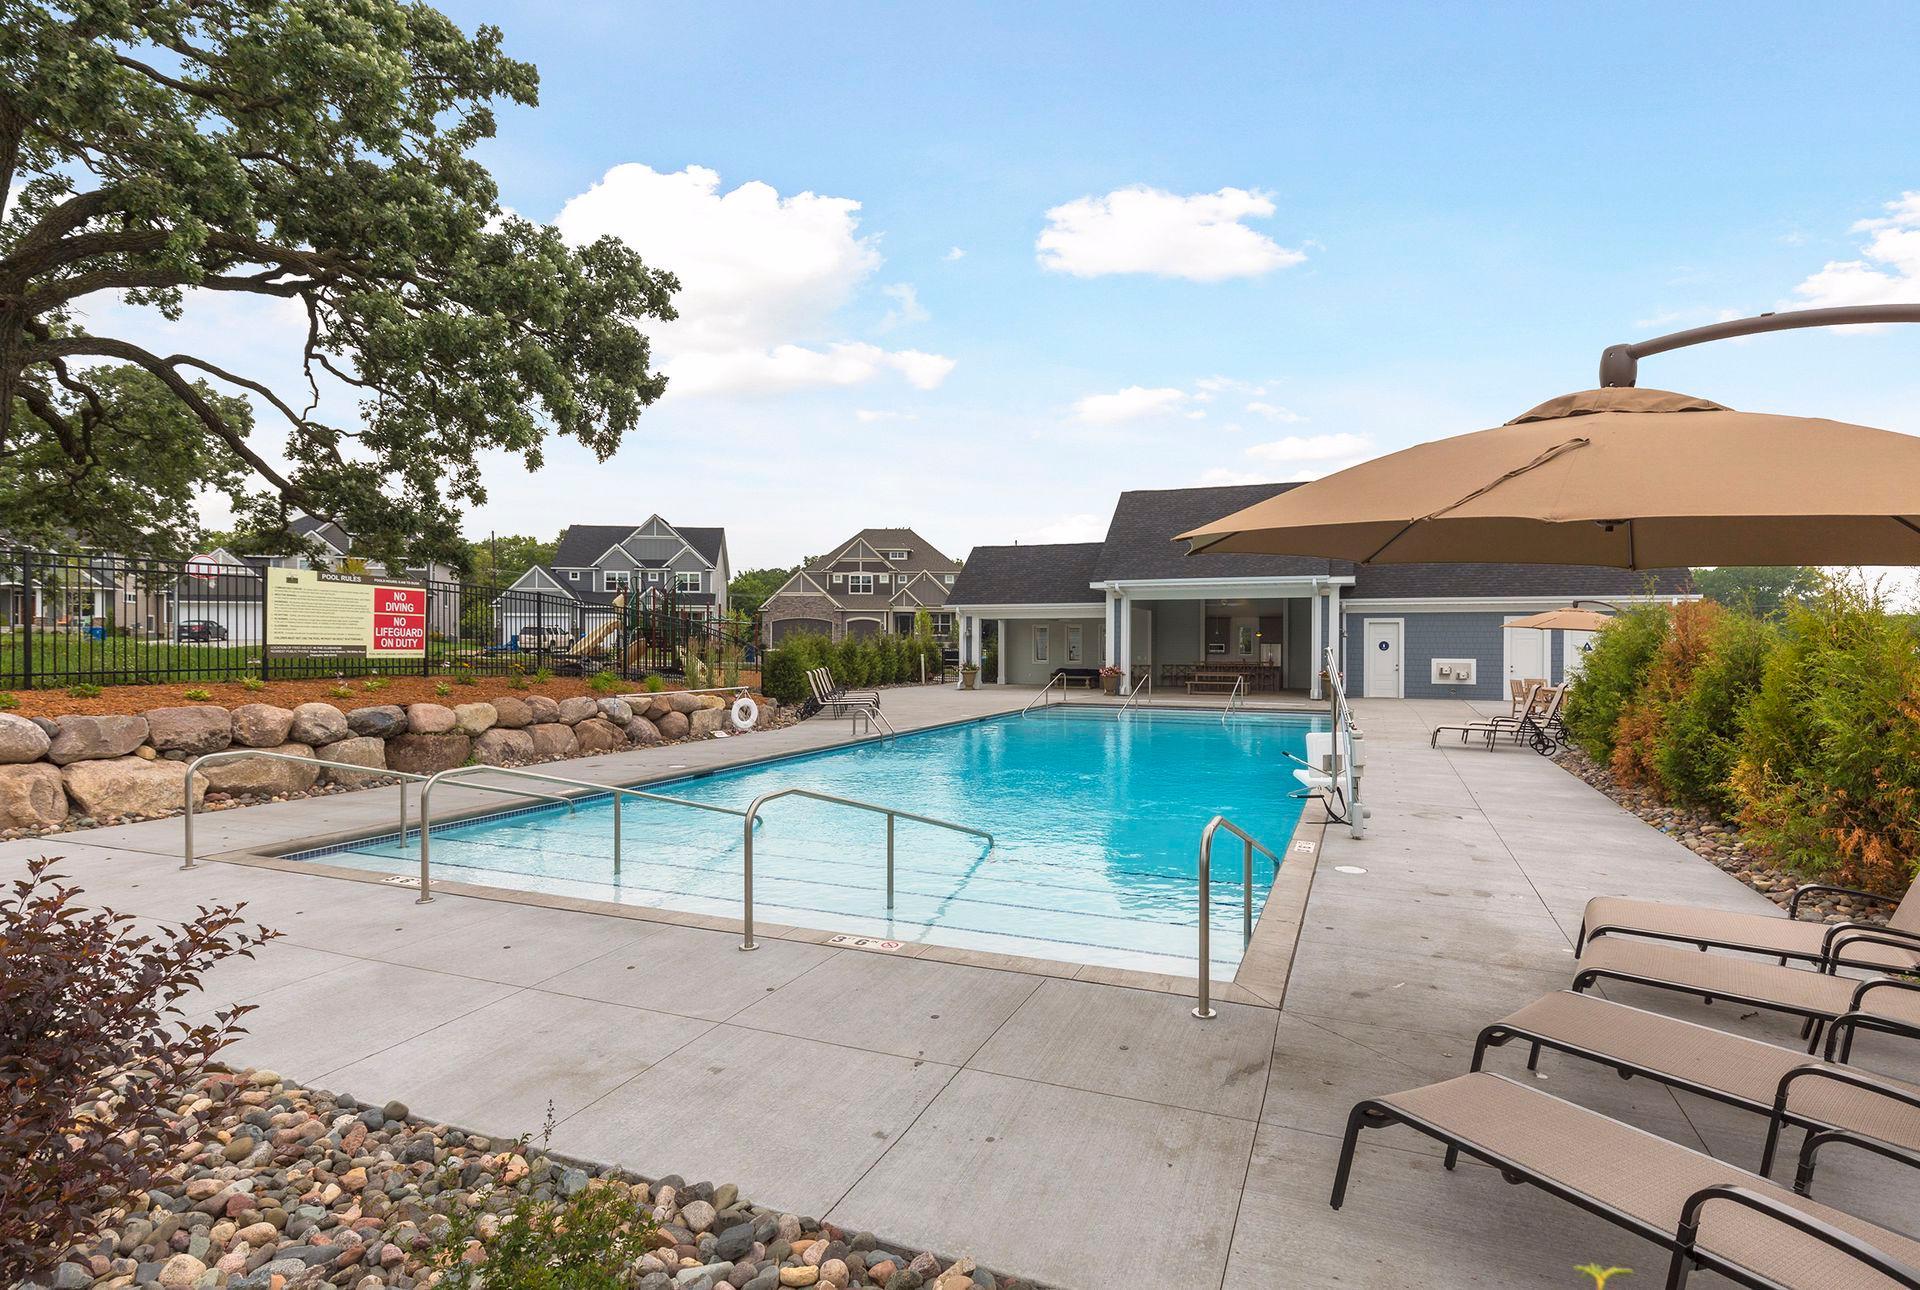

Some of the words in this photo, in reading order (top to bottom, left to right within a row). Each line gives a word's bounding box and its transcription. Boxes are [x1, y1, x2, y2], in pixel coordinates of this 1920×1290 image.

[321, 573, 340, 581] POOL
[341, 575, 362, 583] RULES
[393, 592, 406, 602] NO
[385, 602, 414, 612] DIVING
[393, 617, 406, 626] NO
[375, 627, 423, 638] LIFEGUARD
[380, 638, 394, 648] ON
[395, 638, 418, 648] DUTY
